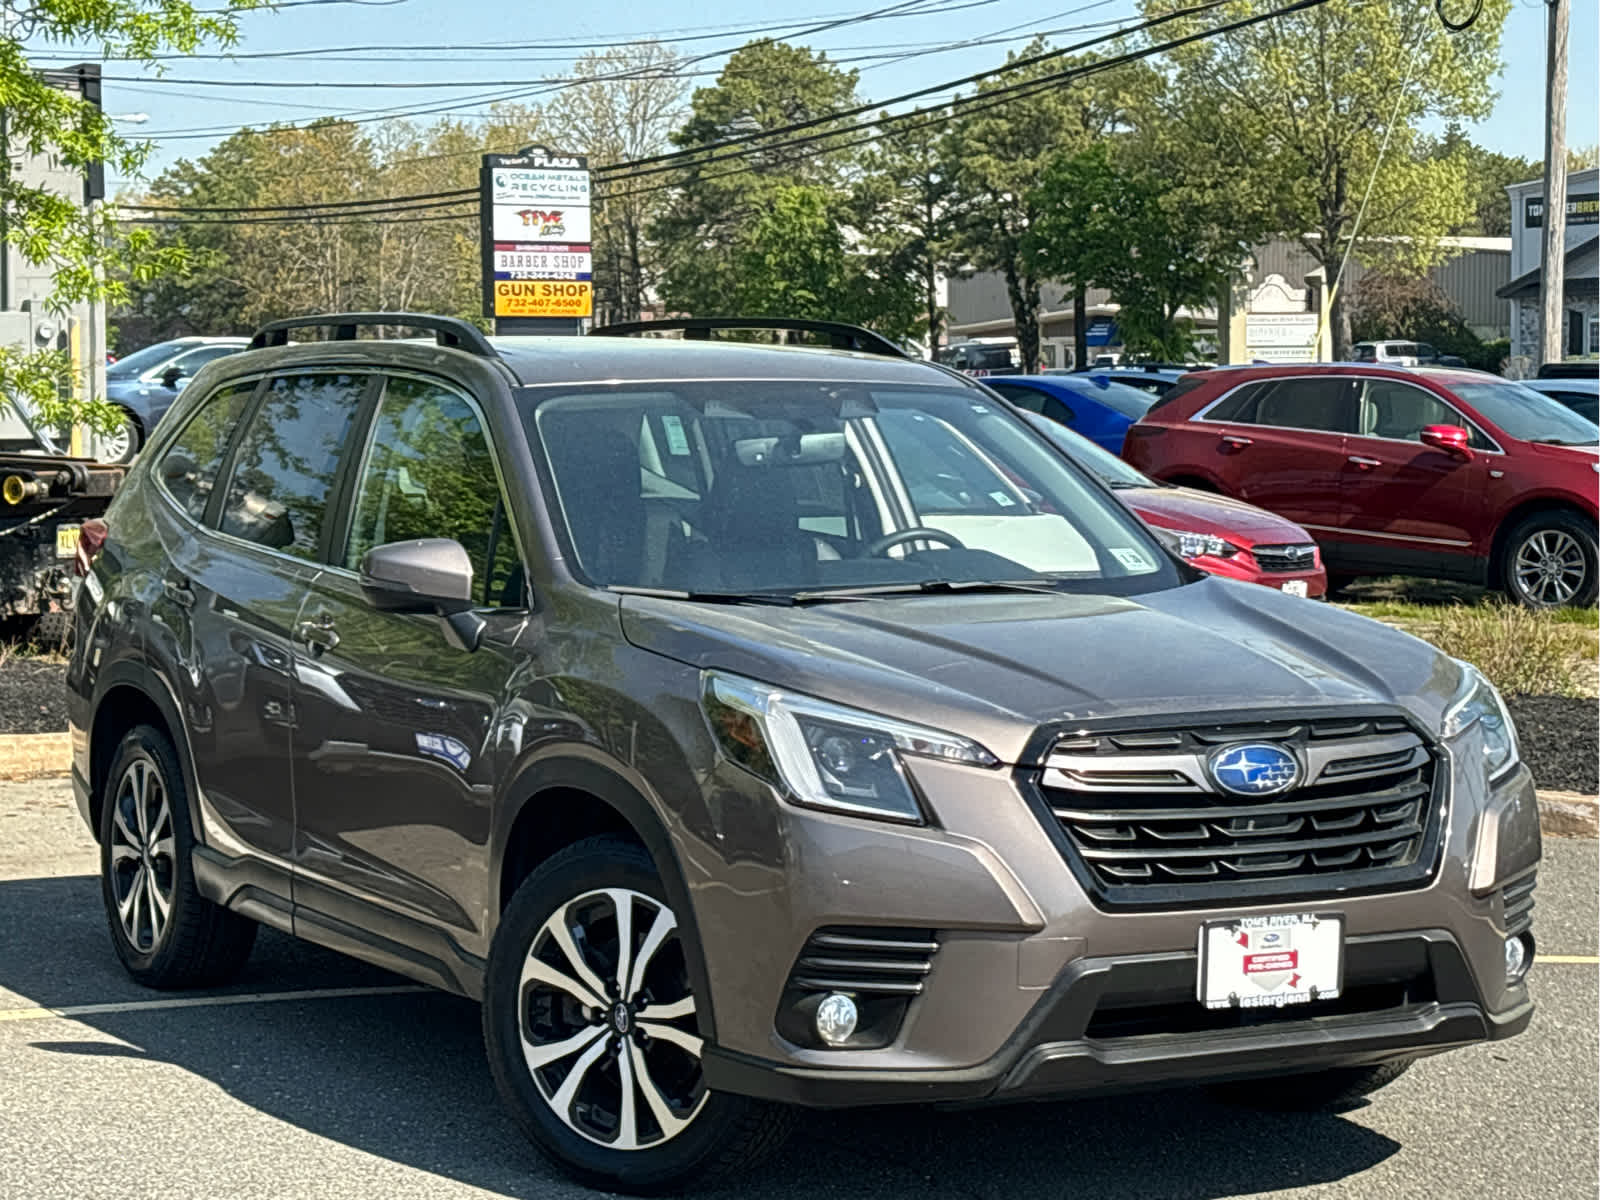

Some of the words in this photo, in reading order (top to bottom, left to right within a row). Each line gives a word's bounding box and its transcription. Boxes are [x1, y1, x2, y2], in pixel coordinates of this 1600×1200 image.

[533, 157, 580, 168] PLAZA
[510, 183, 587, 192] RECYCLING
[500, 255, 548, 268] BARBER
[553, 255, 585, 269] SHOP
[498, 284, 536, 297] GUN
[542, 284, 589, 297] SHOP
[506, 299, 582, 308] 732-407-6500
